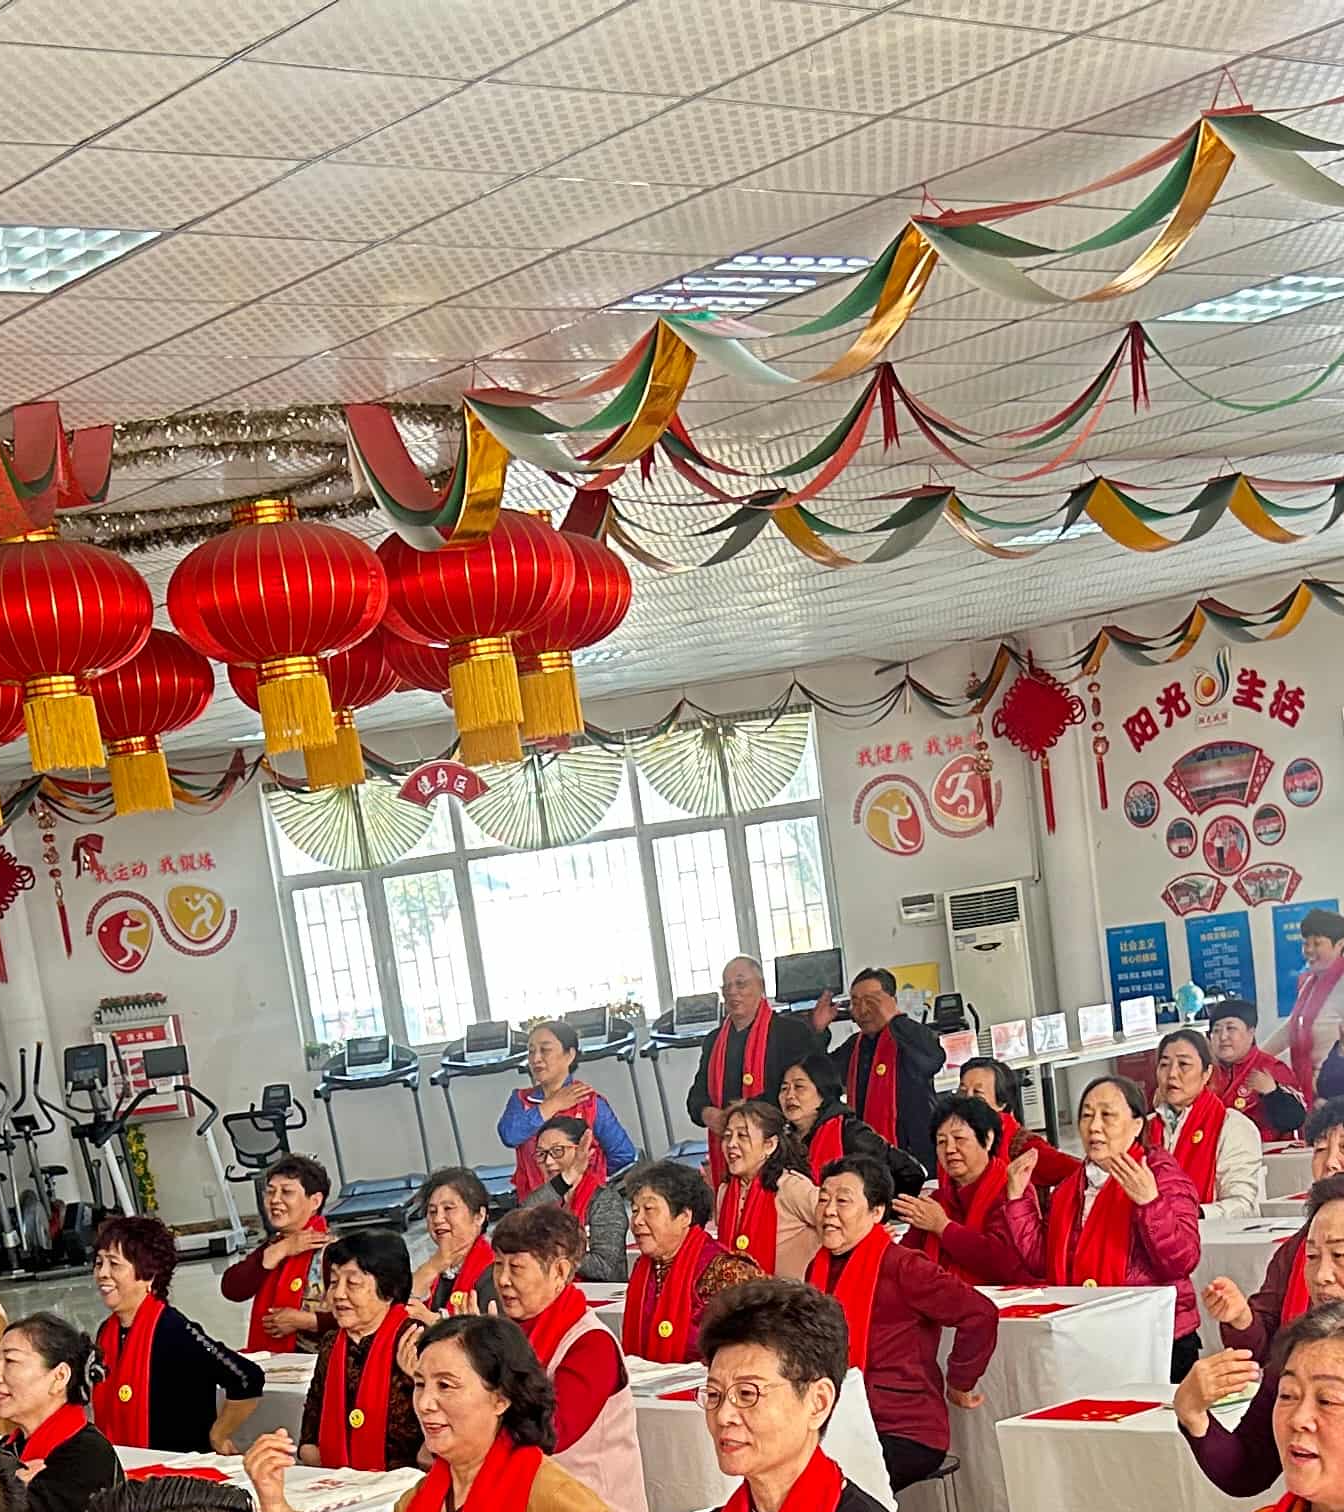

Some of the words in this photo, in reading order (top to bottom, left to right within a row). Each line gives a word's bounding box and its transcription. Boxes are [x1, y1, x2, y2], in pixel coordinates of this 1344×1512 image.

[1123, 682, 1191, 752] 阳光
[1233, 668, 1305, 728] 生活
[417, 768, 468, 796] 健身区
